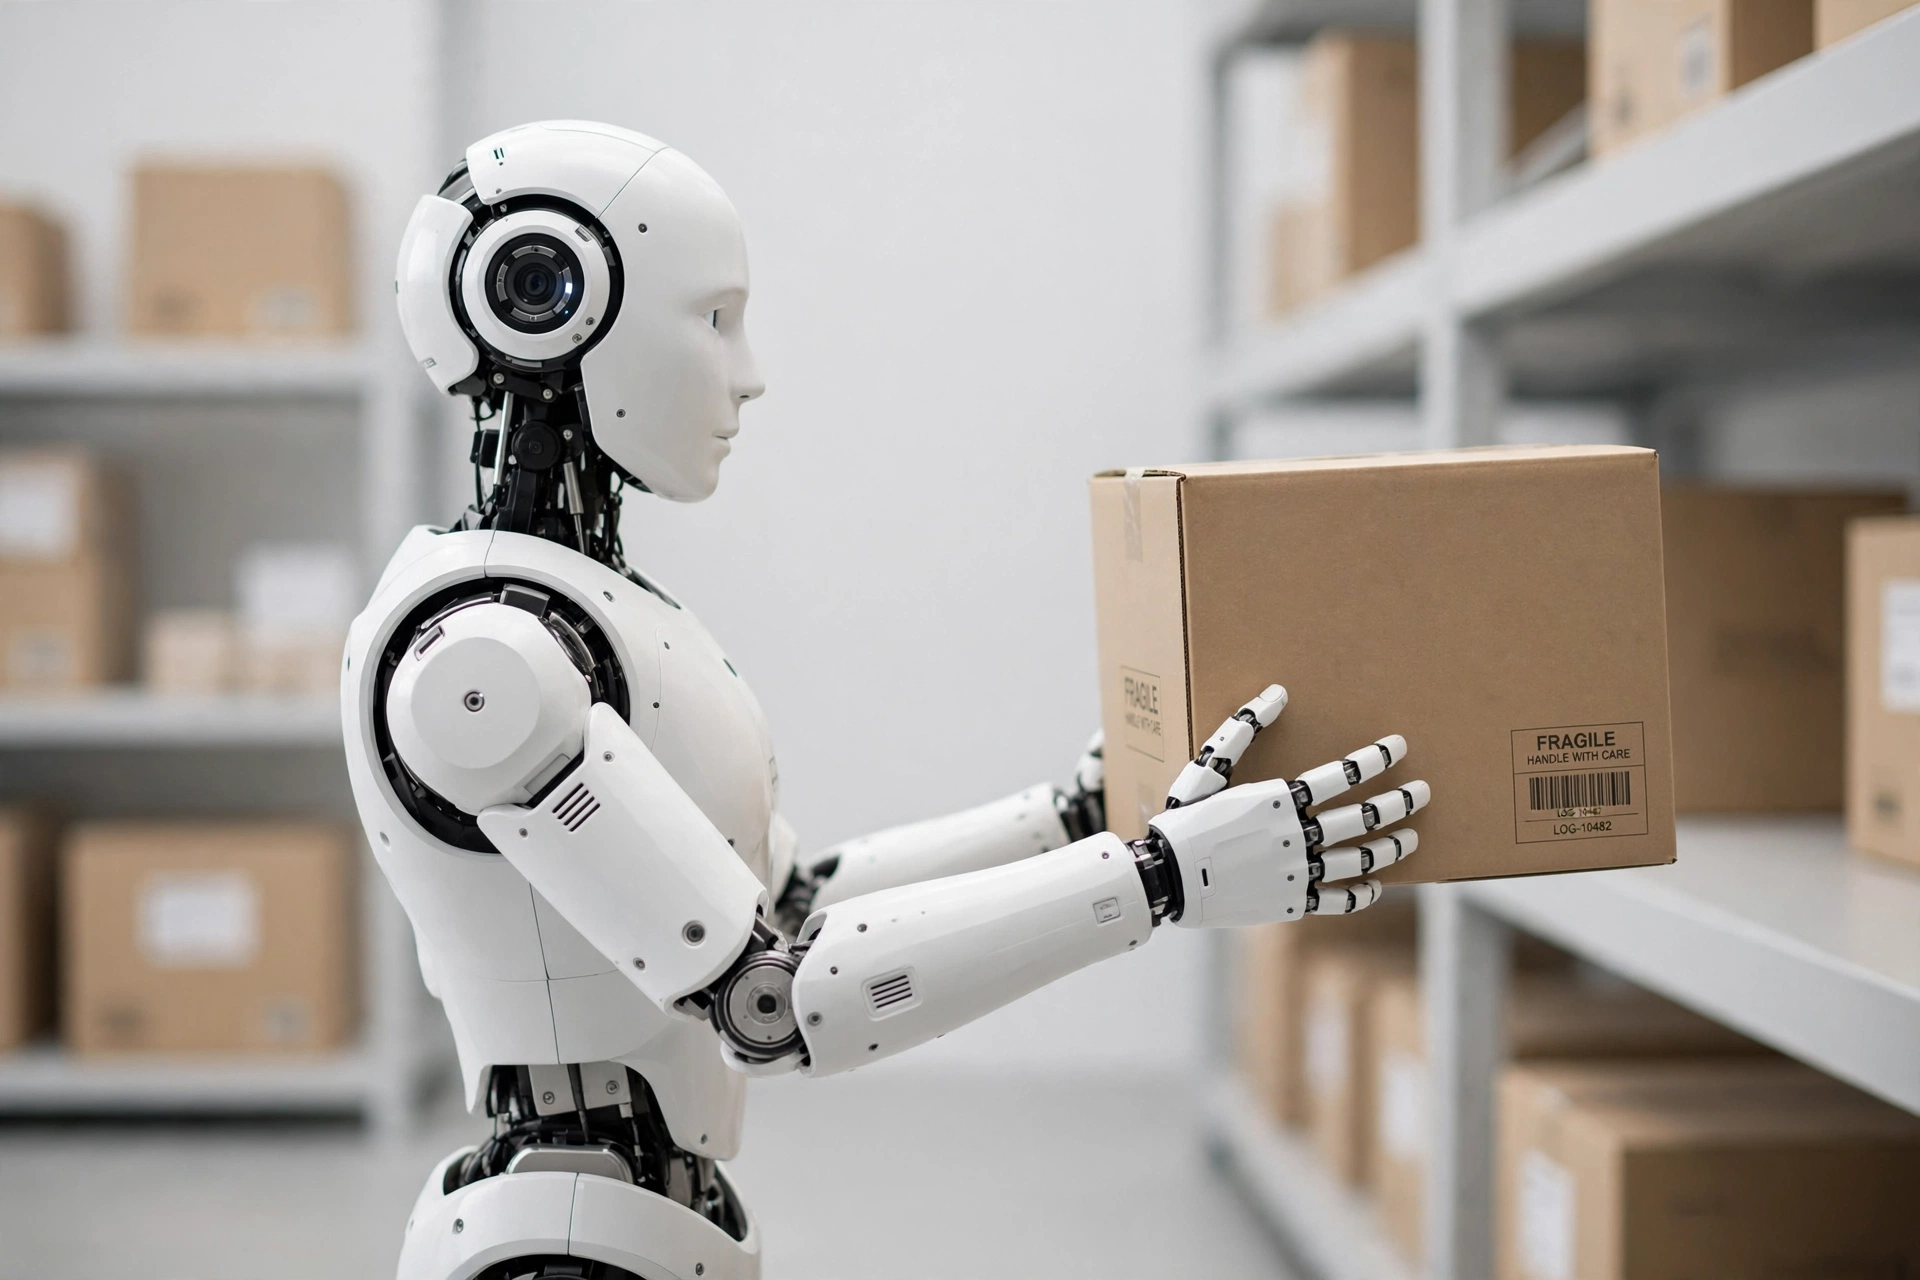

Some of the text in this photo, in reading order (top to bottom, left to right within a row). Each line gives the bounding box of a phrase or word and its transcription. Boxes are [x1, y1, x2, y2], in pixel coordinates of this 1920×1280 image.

[1124, 676, 1158, 715] FRAGILE
[1537, 731, 1616, 751] FRAGILE
[1527, 749, 1631, 765] HANDLE WITH CARE
[1553, 821, 1612, 835] LOG-10482
